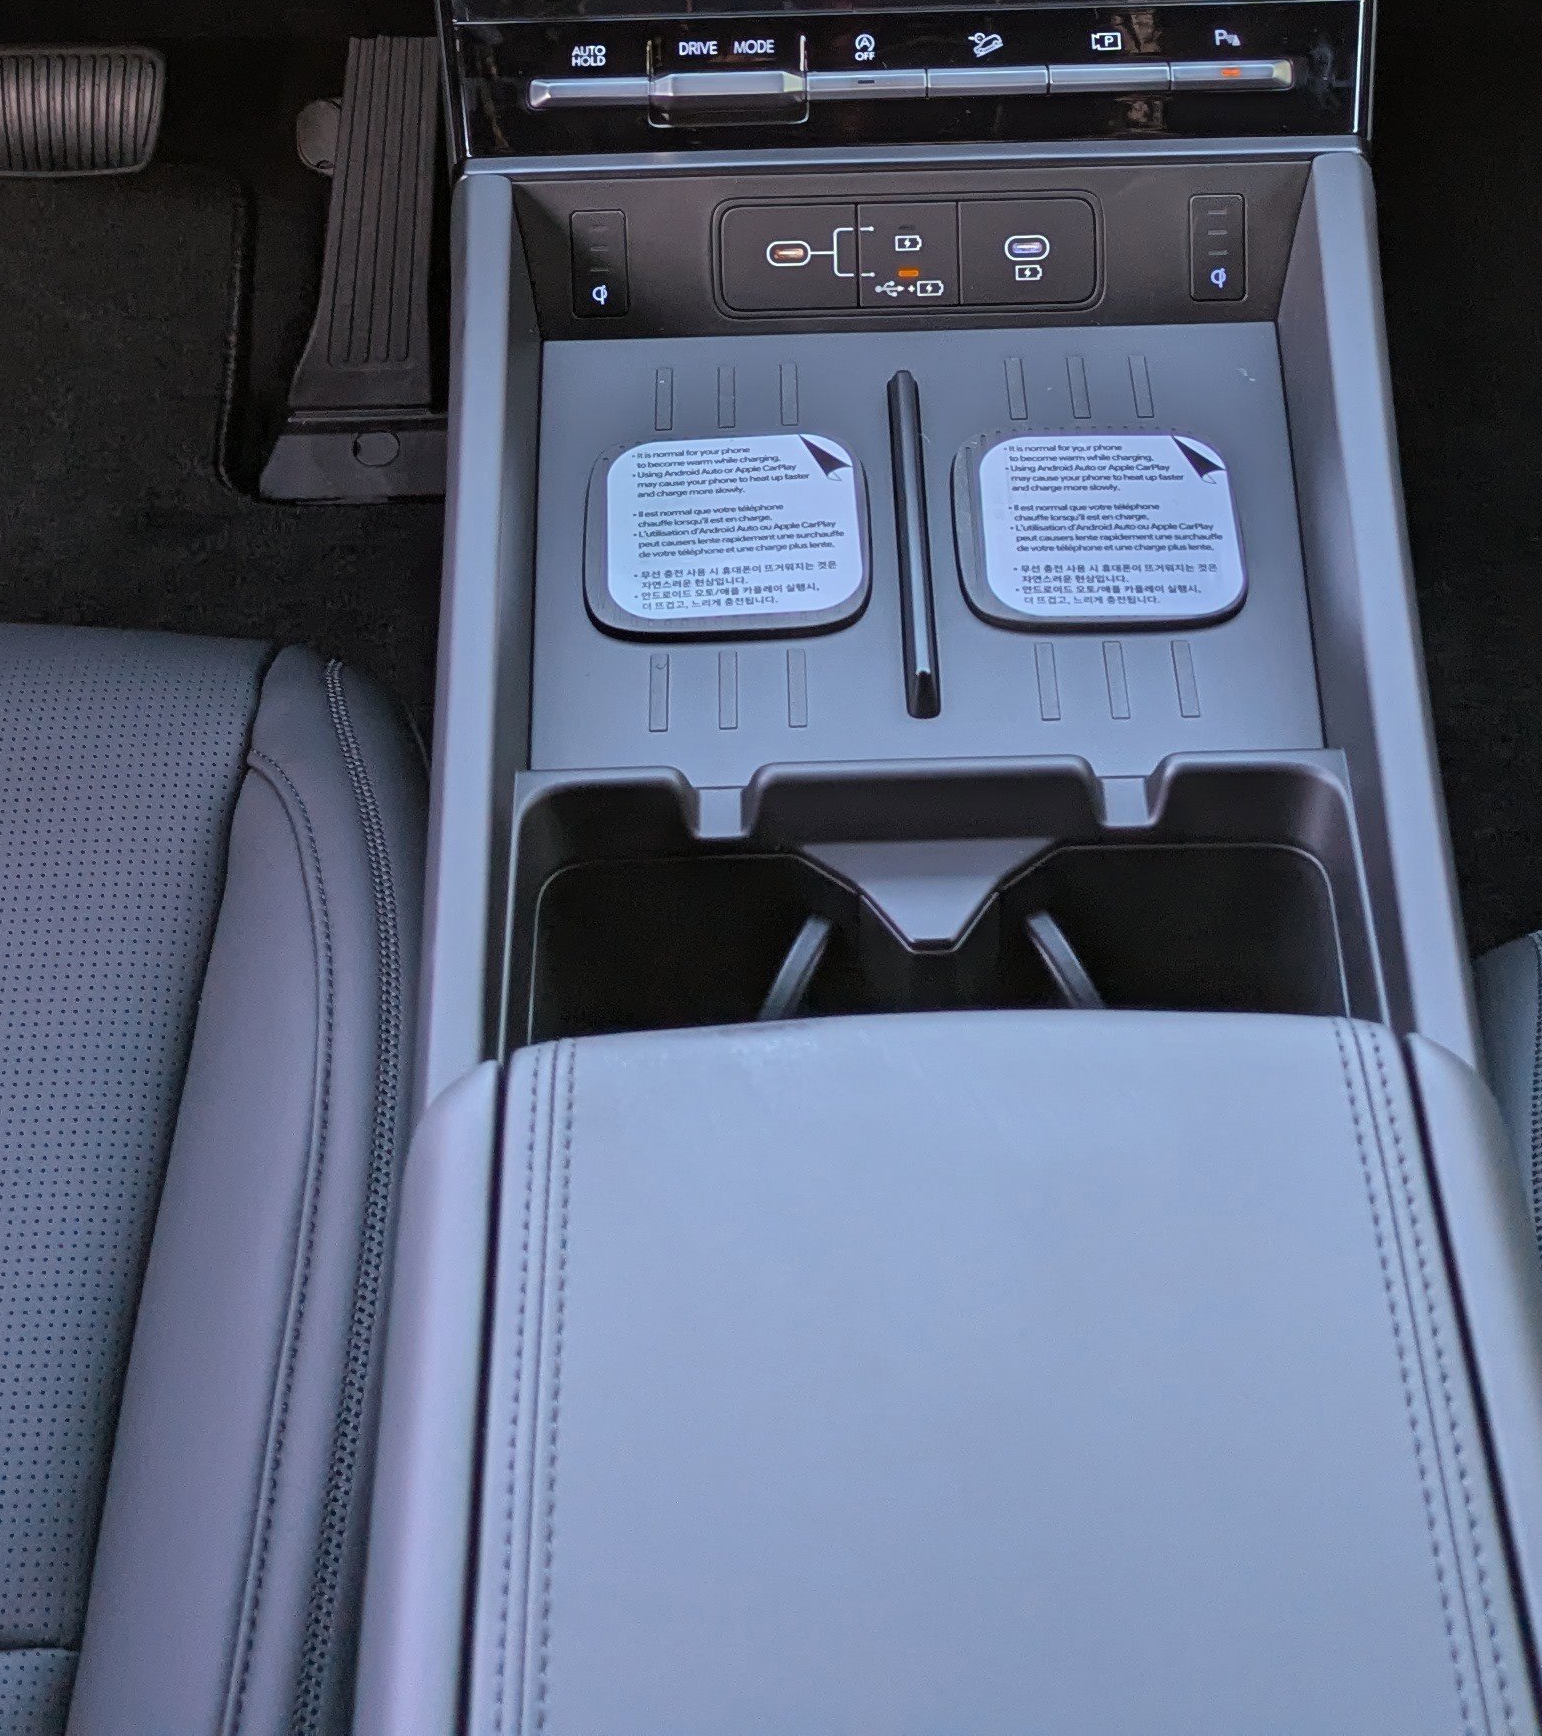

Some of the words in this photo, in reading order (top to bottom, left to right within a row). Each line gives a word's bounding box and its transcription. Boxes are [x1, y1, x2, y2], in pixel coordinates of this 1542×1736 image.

[572, 45, 606, 55] AUTO
[678, 40, 718, 56] DRIVE
[734, 39, 775, 54] MODE
[572, 55, 606, 67] HOLD
[855, 52, 875, 61] OFF
[1071, 445, 1091, 453] your
[1093, 444, 1123, 452] phone
[1011, 465, 1036, 473] Using
[1038, 464, 1073, 472] Android
[1108, 464, 1134, 472] Apple
[1135, 463, 1170, 472] CarPlay
